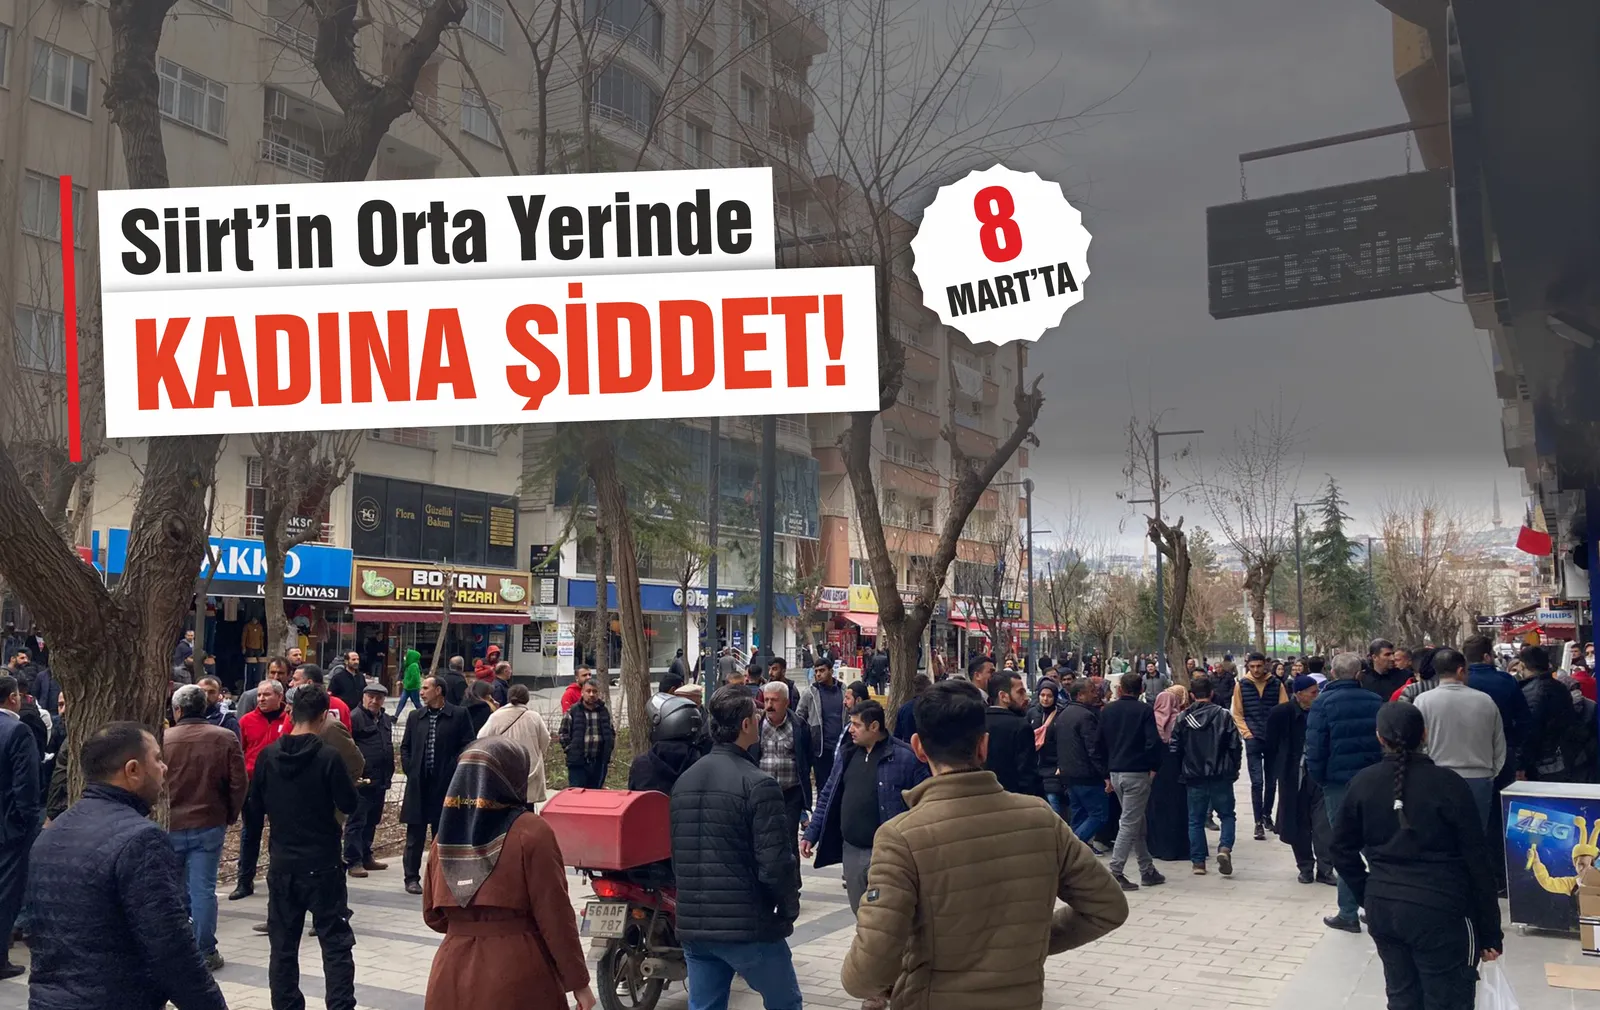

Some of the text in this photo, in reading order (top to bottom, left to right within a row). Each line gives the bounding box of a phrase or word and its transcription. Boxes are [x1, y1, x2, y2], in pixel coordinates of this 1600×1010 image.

[1209, 230, 1444, 299] TEKNİK
[396, 508, 416, 520] Flora
[286, 584, 339, 598] DÜNYASI
[454, 590, 497, 603] AZARI
[601, 920, 622, 931] 787
